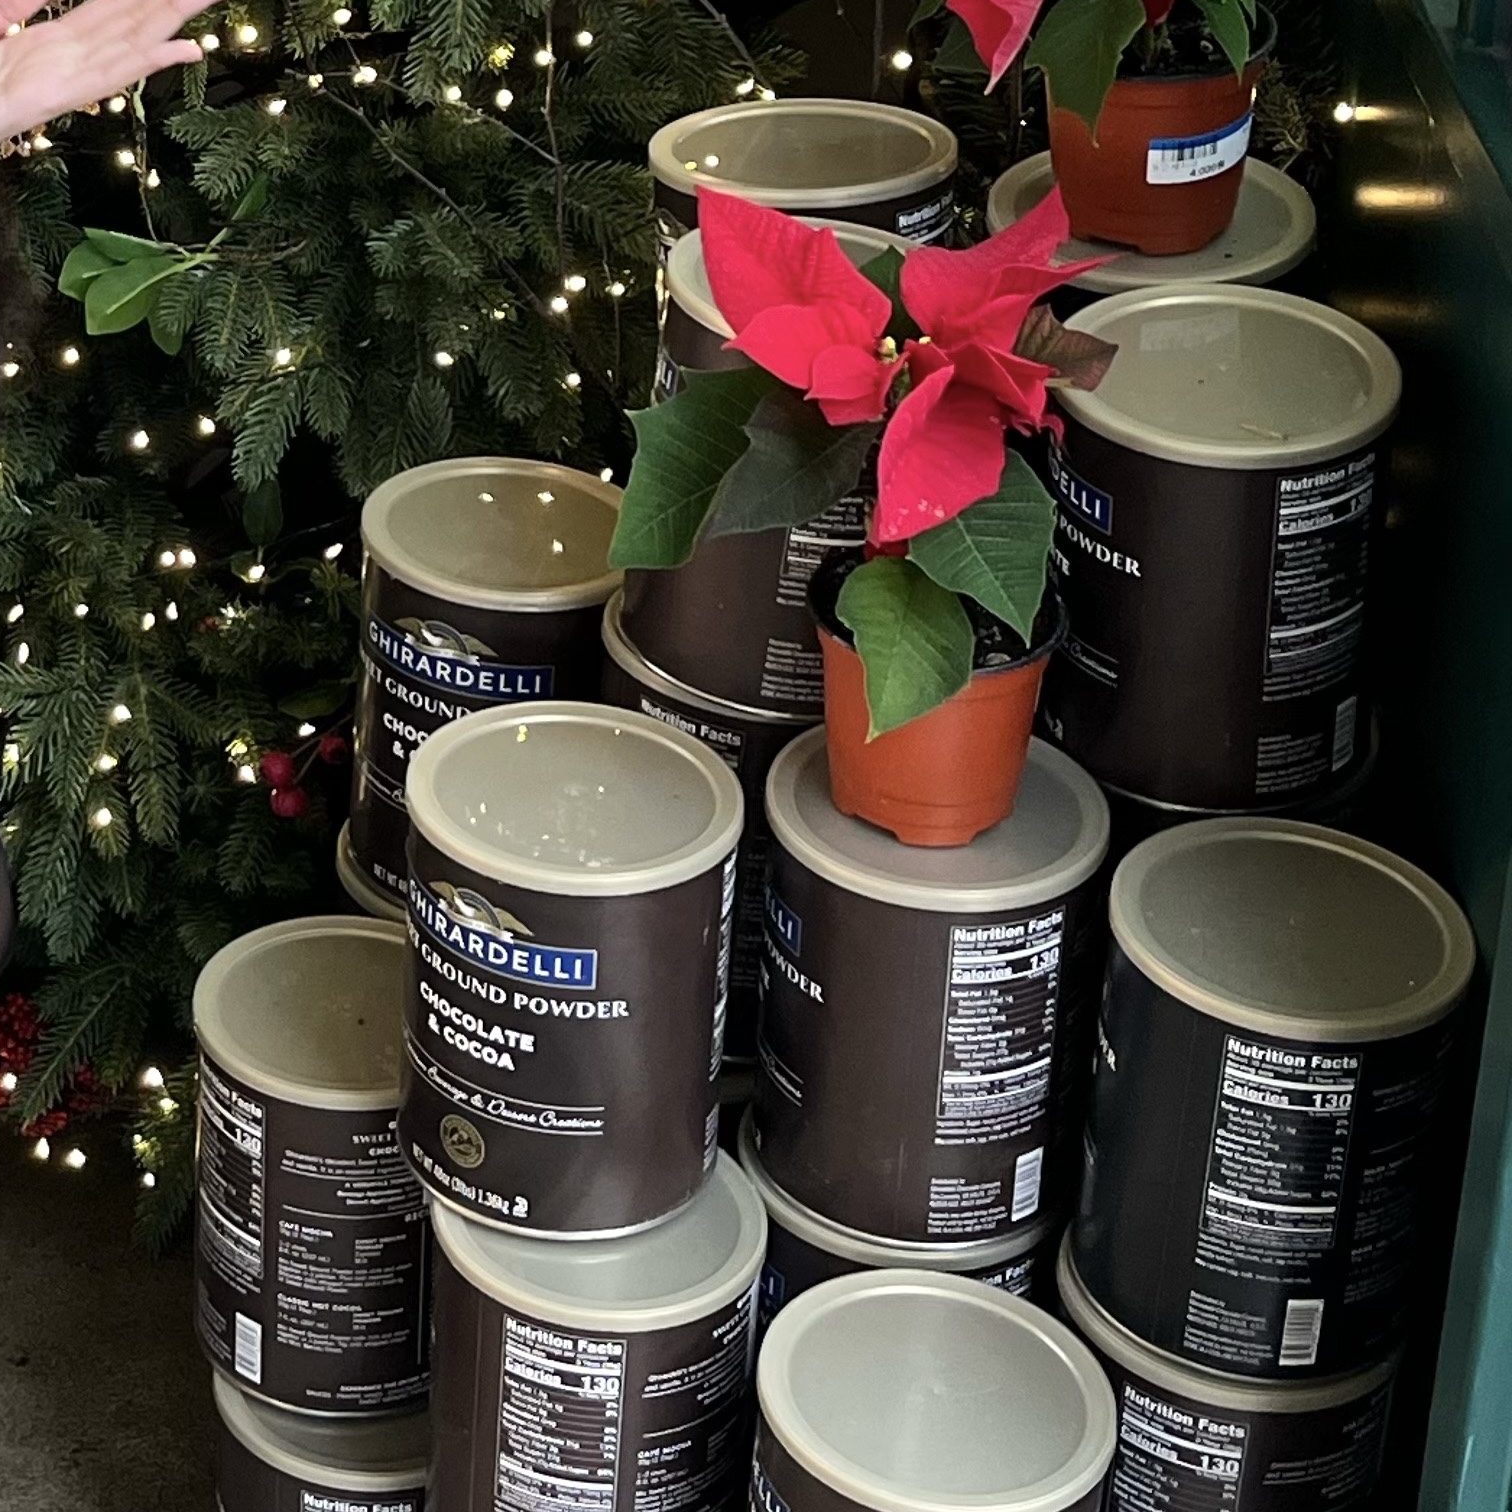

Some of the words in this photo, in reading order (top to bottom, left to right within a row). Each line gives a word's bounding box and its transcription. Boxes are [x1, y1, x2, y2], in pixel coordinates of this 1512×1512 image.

[1280, 469, 1345, 493] Nutrition
[1060, 514, 1141, 577] POWDER
[369, 620, 541, 694] GHIRARDELLI
[383, 712, 430, 745] CHOC
[641, 699, 696, 734] Nutrition
[700, 724, 741, 747] Facts
[409, 879, 582, 980] GHIRARDELLI
[953, 926, 1025, 942] Nutrition
[1028, 911, 1063, 934] Facts
[421, 942, 506, 1005] GROUND
[514, 992, 630, 1019] POWDER
[952, 967, 1013, 980] Calories
[1030, 946, 1059, 970] 130
[420, 981, 535, 1052] CHOCOLATE
[428, 1013, 441, 1036] &
[443, 1025, 515, 1071] COCOA
[1228, 1038, 1306, 1067] Nutrition
[1311, 1055, 1358, 1069] Facts
[1224, 1080, 1289, 1105] Calories
[1312, 1093, 1352, 1108] 130
[506, 1317, 573, 1351] Nutrition
[577, 1339, 622, 1355] Facts
[506, 1357, 562, 1387] Calories
[580, 1375, 620, 1392] 130
[1124, 1386, 1194, 1426] Nutrition
[1198, 1418, 1245, 1438] Facts
[1121, 1424, 1178, 1461] Calories
[1200, 1455, 1239, 1473] 130
[304, 1493, 368, 1512] Nutrition
